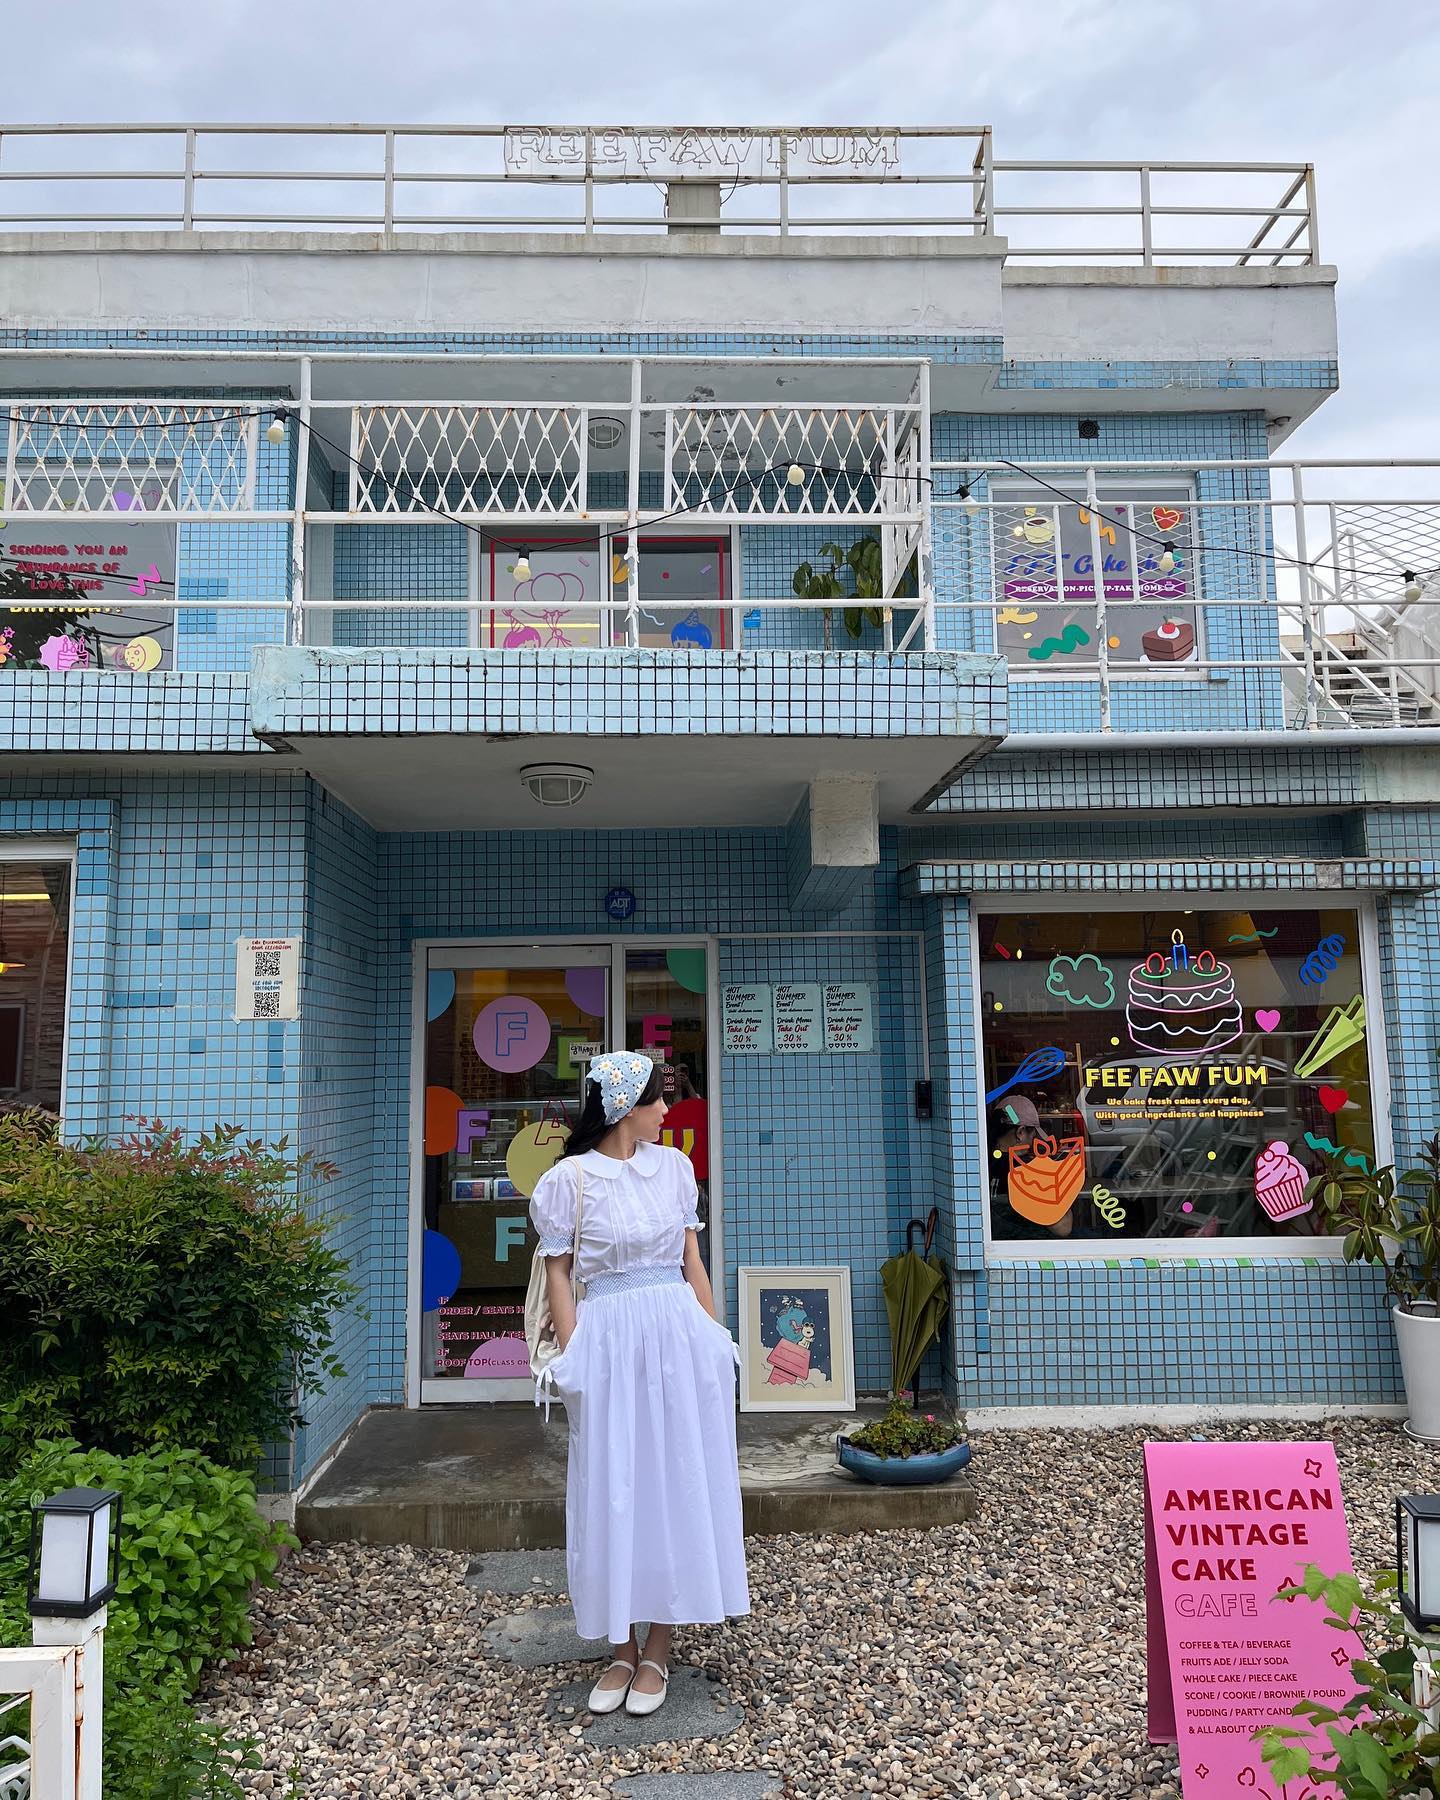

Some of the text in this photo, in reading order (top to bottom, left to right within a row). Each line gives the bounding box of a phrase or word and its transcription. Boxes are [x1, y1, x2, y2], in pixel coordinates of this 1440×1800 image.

[507, 127, 900, 166] FEE FAW FUM
[9, 544, 128, 556] SENDING YOU AN
[16, 561, 121, 574] ABUNDANCE OF
[1074, 553, 1130, 576] Cke
[30, 579, 104, 591] LOVE THIS
[826, 992, 856, 1000] SUMMER
[727, 1025, 759, 1033] Take Out
[777, 1024, 809, 1033] Take Out
[827, 1024, 860, 1032] Take Out
[496, 1012, 528, 1056] F
[1086, 1065, 1269, 1088] FEE FAW FUM
[1107, 1098, 1121, 1106] We
[1124, 1098, 1145, 1106] bake
[1148, 1097, 1172, 1106] fresh
[1203, 1098, 1229, 1106] every
[1230, 1097, 1251, 1106] day,
[1095, 1109, 1265, 1120] With good ingredients and happiness
[457, 1110, 489, 1155] F
[496, 1217, 528, 1262] F
[437, 1296, 449, 1305] 1F
[437, 1307, 473, 1316] ORDER
[482, 1306, 515, 1315] SEATS
[437, 1321, 451, 1330] 2F
[437, 1331, 470, 1340] SEATS
[470, 1331, 496, 1340] HALL
[437, 1348, 450, 1357] 3F
[437, 1358, 467, 1367] ROOF
[1164, 1489, 1333, 1511] AMERICAN
[1166, 1523, 1309, 1546] VINTAGE
[1171, 1558, 1257, 1581] CAKE
[1175, 1593, 1258, 1617] CAFE
[1179, 1641, 1212, 1649] COFFEE
[1213, 1641, 1220, 1649] &
[1221, 1641, 1239, 1649] TEA
[1246, 1640, 1291, 1649] BEVERAGE
[1181, 1658, 1212, 1666] FRUITS
[1213, 1658, 1232, 1666] ADE
[1238, 1657, 1262, 1665] JELLY
[1264, 1657, 1289, 1665] SODA
[1183, 1675, 1216, 1683] WHOLE
[1217, 1674, 1241, 1683] CAKE
[1248, 1674, 1272, 1682] PIECE
[1274, 1673, 1298, 1682] CAKE
[1184, 1692, 1215, 1700] SCONE
[1223, 1691, 1256, 1699] COOKIE
[1264, 1690, 1306, 1699] BROWNIE
[1313, 1689, 1346, 1698] POUND
[1186, 1709, 1228, 1717] PUDDING
[1235, 1708, 1265, 1716] PARTY
[1188, 1726, 1195, 1734] &
[1197, 1726, 1214, 1734] ALL
[1215, 1725, 1246, 1733] ABOUT
